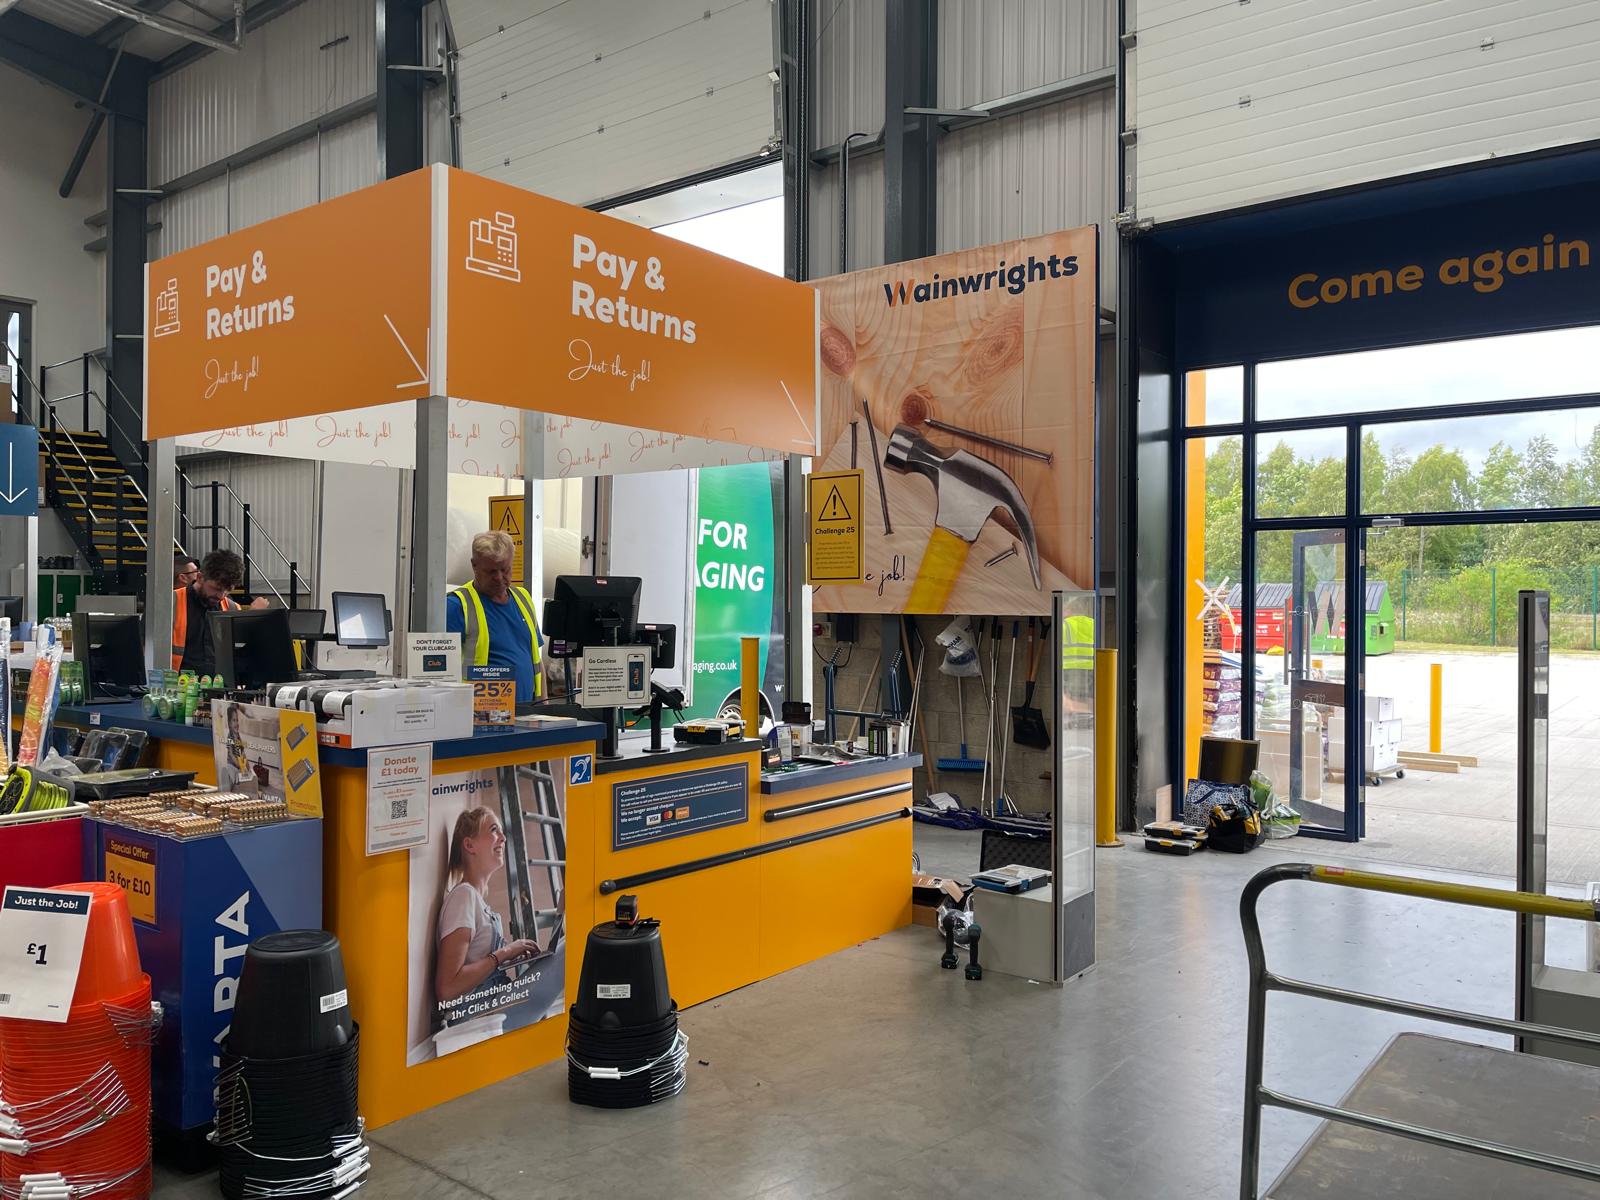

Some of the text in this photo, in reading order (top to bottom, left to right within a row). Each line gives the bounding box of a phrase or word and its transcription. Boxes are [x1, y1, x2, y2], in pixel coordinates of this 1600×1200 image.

[206, 250, 267, 298] Pay &
[573, 234, 666, 292] Pay &
[1288, 233, 1590, 308] Come again
[883, 254, 1079, 308] Wainwrights
[206, 295, 295, 340] Returns
[571, 280, 697, 344] Returns
[204, 355, 259, 399] Just the job!
[567, 338, 651, 392] Just the job!
[246, 424, 265, 438] the
[269, 420, 289, 448] job!
[315, 415, 392, 448] Just the job!
[466, 423, 481, 449] job!
[698, 518, 748, 550] FOR
[814, 526, 855, 536] Challenge 25
[878, 554, 906, 597] job!
[473, 682, 513, 698] 25%
[384, 756, 417, 766] Donate
[393, 765, 420, 775] today
[431, 779, 494, 796] ainwrights
[110, 839, 149, 860] Special Offer
[109, 869, 151, 897] 3 for £10
[14, 895, 79, 910] Just the Job!
[26, 943, 48, 965] £1
[438, 971, 541, 1011] Need something quick?
[451, 989, 530, 1021] 1hr Click & Collect
